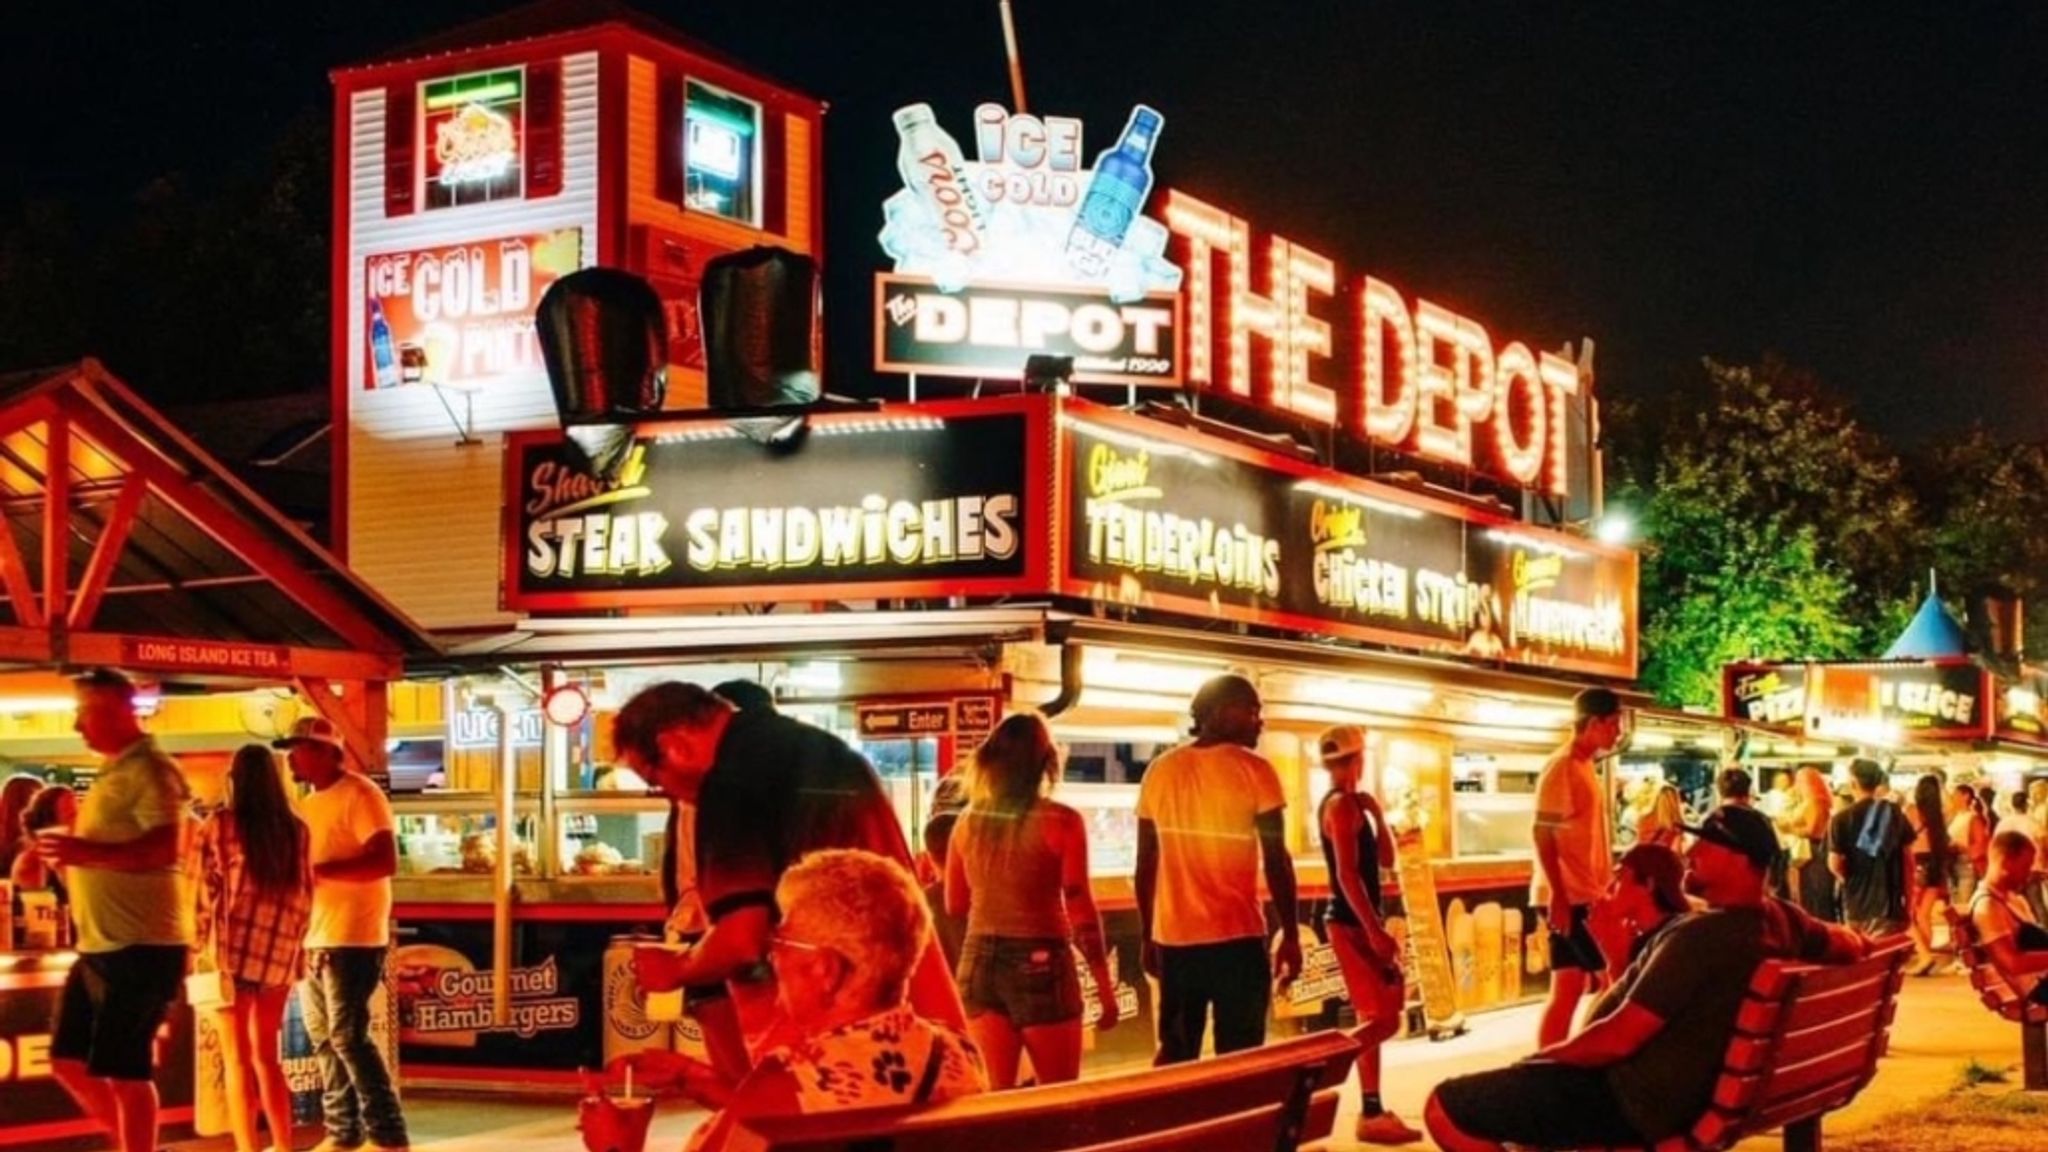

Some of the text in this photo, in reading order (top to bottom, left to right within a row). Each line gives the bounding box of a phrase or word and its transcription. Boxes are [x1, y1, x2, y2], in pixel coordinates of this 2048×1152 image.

[951, 164, 986, 230] LIGHT
[979, 170, 1079, 207] COLD
[412, 239, 530, 323] COLD
[914, 293, 1171, 354] DEPOT
[1165, 188, 1579, 497] THE DEPOT
[527, 511, 672, 578] STEAK
[138, 643, 278, 668] LONG ISLAND ICE TEA
[908, 711, 944, 731] Enter
[440, 966, 554, 996] Goumet
[418, 1002, 575, 1032] Hambrgers
